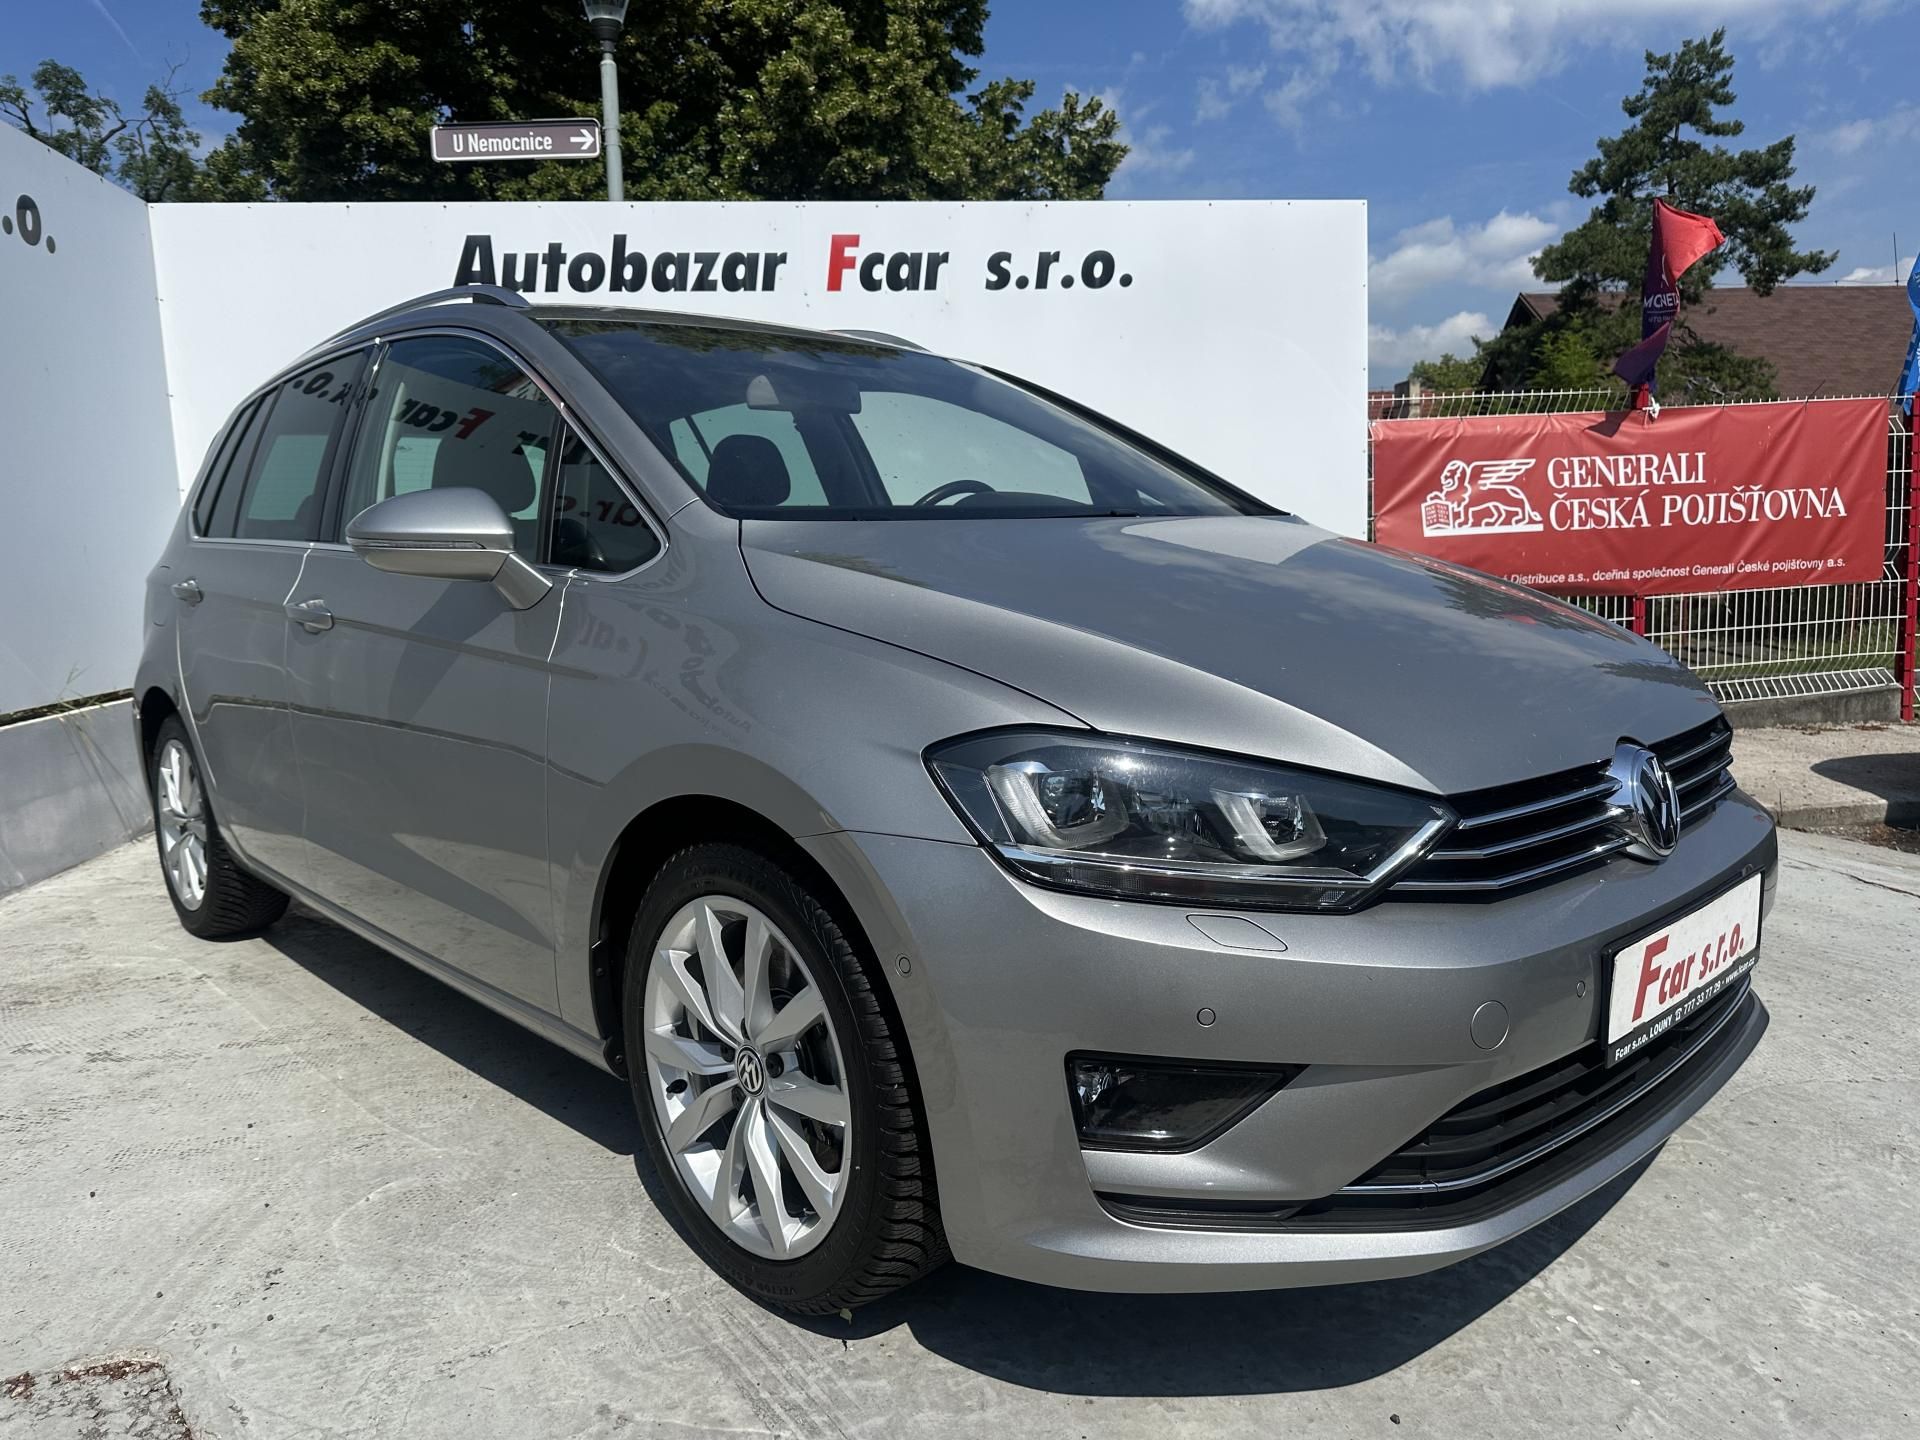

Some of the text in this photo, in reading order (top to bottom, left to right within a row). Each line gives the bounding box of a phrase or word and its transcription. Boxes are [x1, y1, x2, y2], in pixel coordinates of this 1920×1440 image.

[453, 132, 552, 152] U Nemocnice
[453, 233, 1133, 292] Autobazar Fcar s.r.o.
[1547, 451, 1707, 489] GENERALI
[1549, 484, 1848, 531] ČESKÁ POJIŠŤOVNA
[1510, 572, 1566, 585] Distribuce
[1592, 568, 1630, 581] dceřiná
[1632, 565, 1690, 580] společnost
[1692, 562, 1735, 576] Generali
[1736, 560, 1770, 573] České
[1772, 558, 1824, 573] pojišťovny
[1826, 558, 1846, 567] a.s.
[1632, 923, 1744, 1023] Fcar s.r.o.
[1615, 1041, 1631, 1061] Fcar
[1632, 1033, 1648, 1050] s.r.o.
[1650, 1014, 1673, 1039] LOUNY
[1683, 998, 1696, 1014] 777
[1696, 992, 1705, 1006] 33
[1705, 986, 1713, 999] 77
